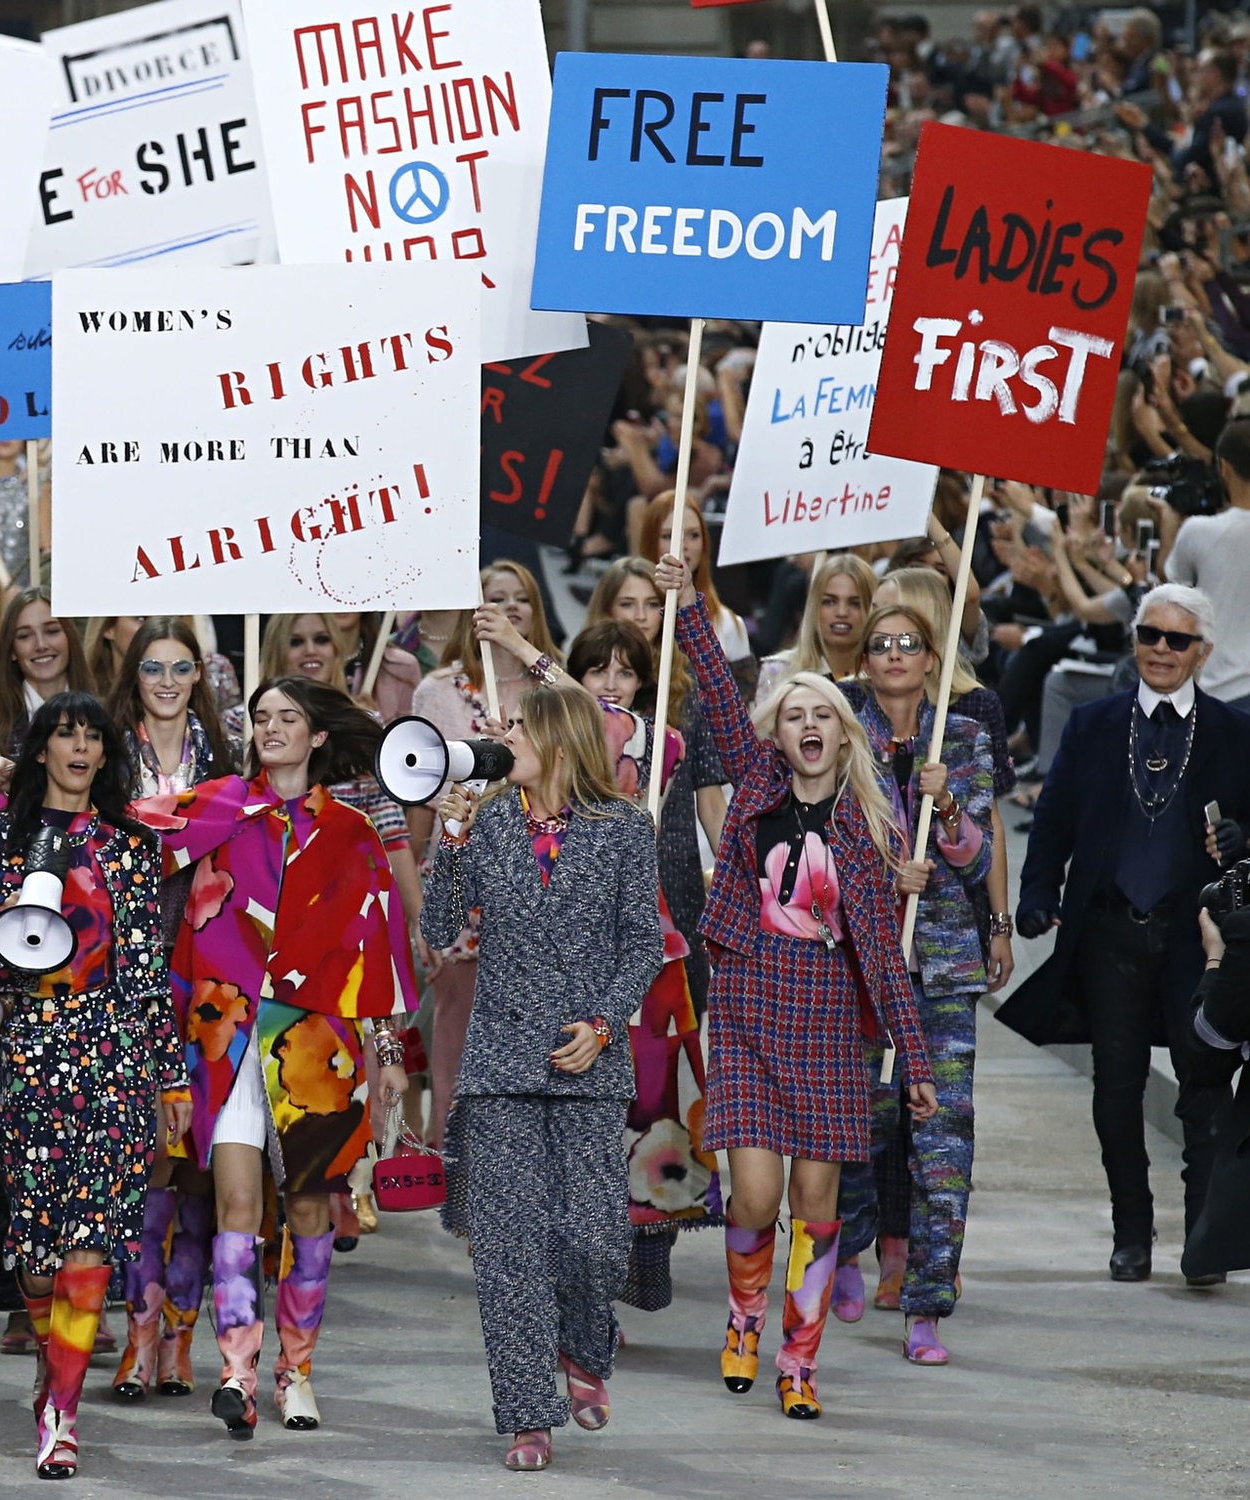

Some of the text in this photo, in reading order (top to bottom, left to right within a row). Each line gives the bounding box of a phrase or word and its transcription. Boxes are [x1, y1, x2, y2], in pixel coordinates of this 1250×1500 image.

[81, 42, 219, 99] DIVORCE
[293, 4, 463, 90] MAKE
[300, 71, 521, 163] FASHION
[587, 88, 768, 168] FREE
[136, 118, 257, 196] SHE
[573, 203, 839, 262] FREEDOM
[77, 309, 234, 334] WOMEN'S
[217, 325, 455, 410] RIGHTS
[75, 435, 361, 465] ARE MORE THAN
[763, 482, 891, 527] Libertine
